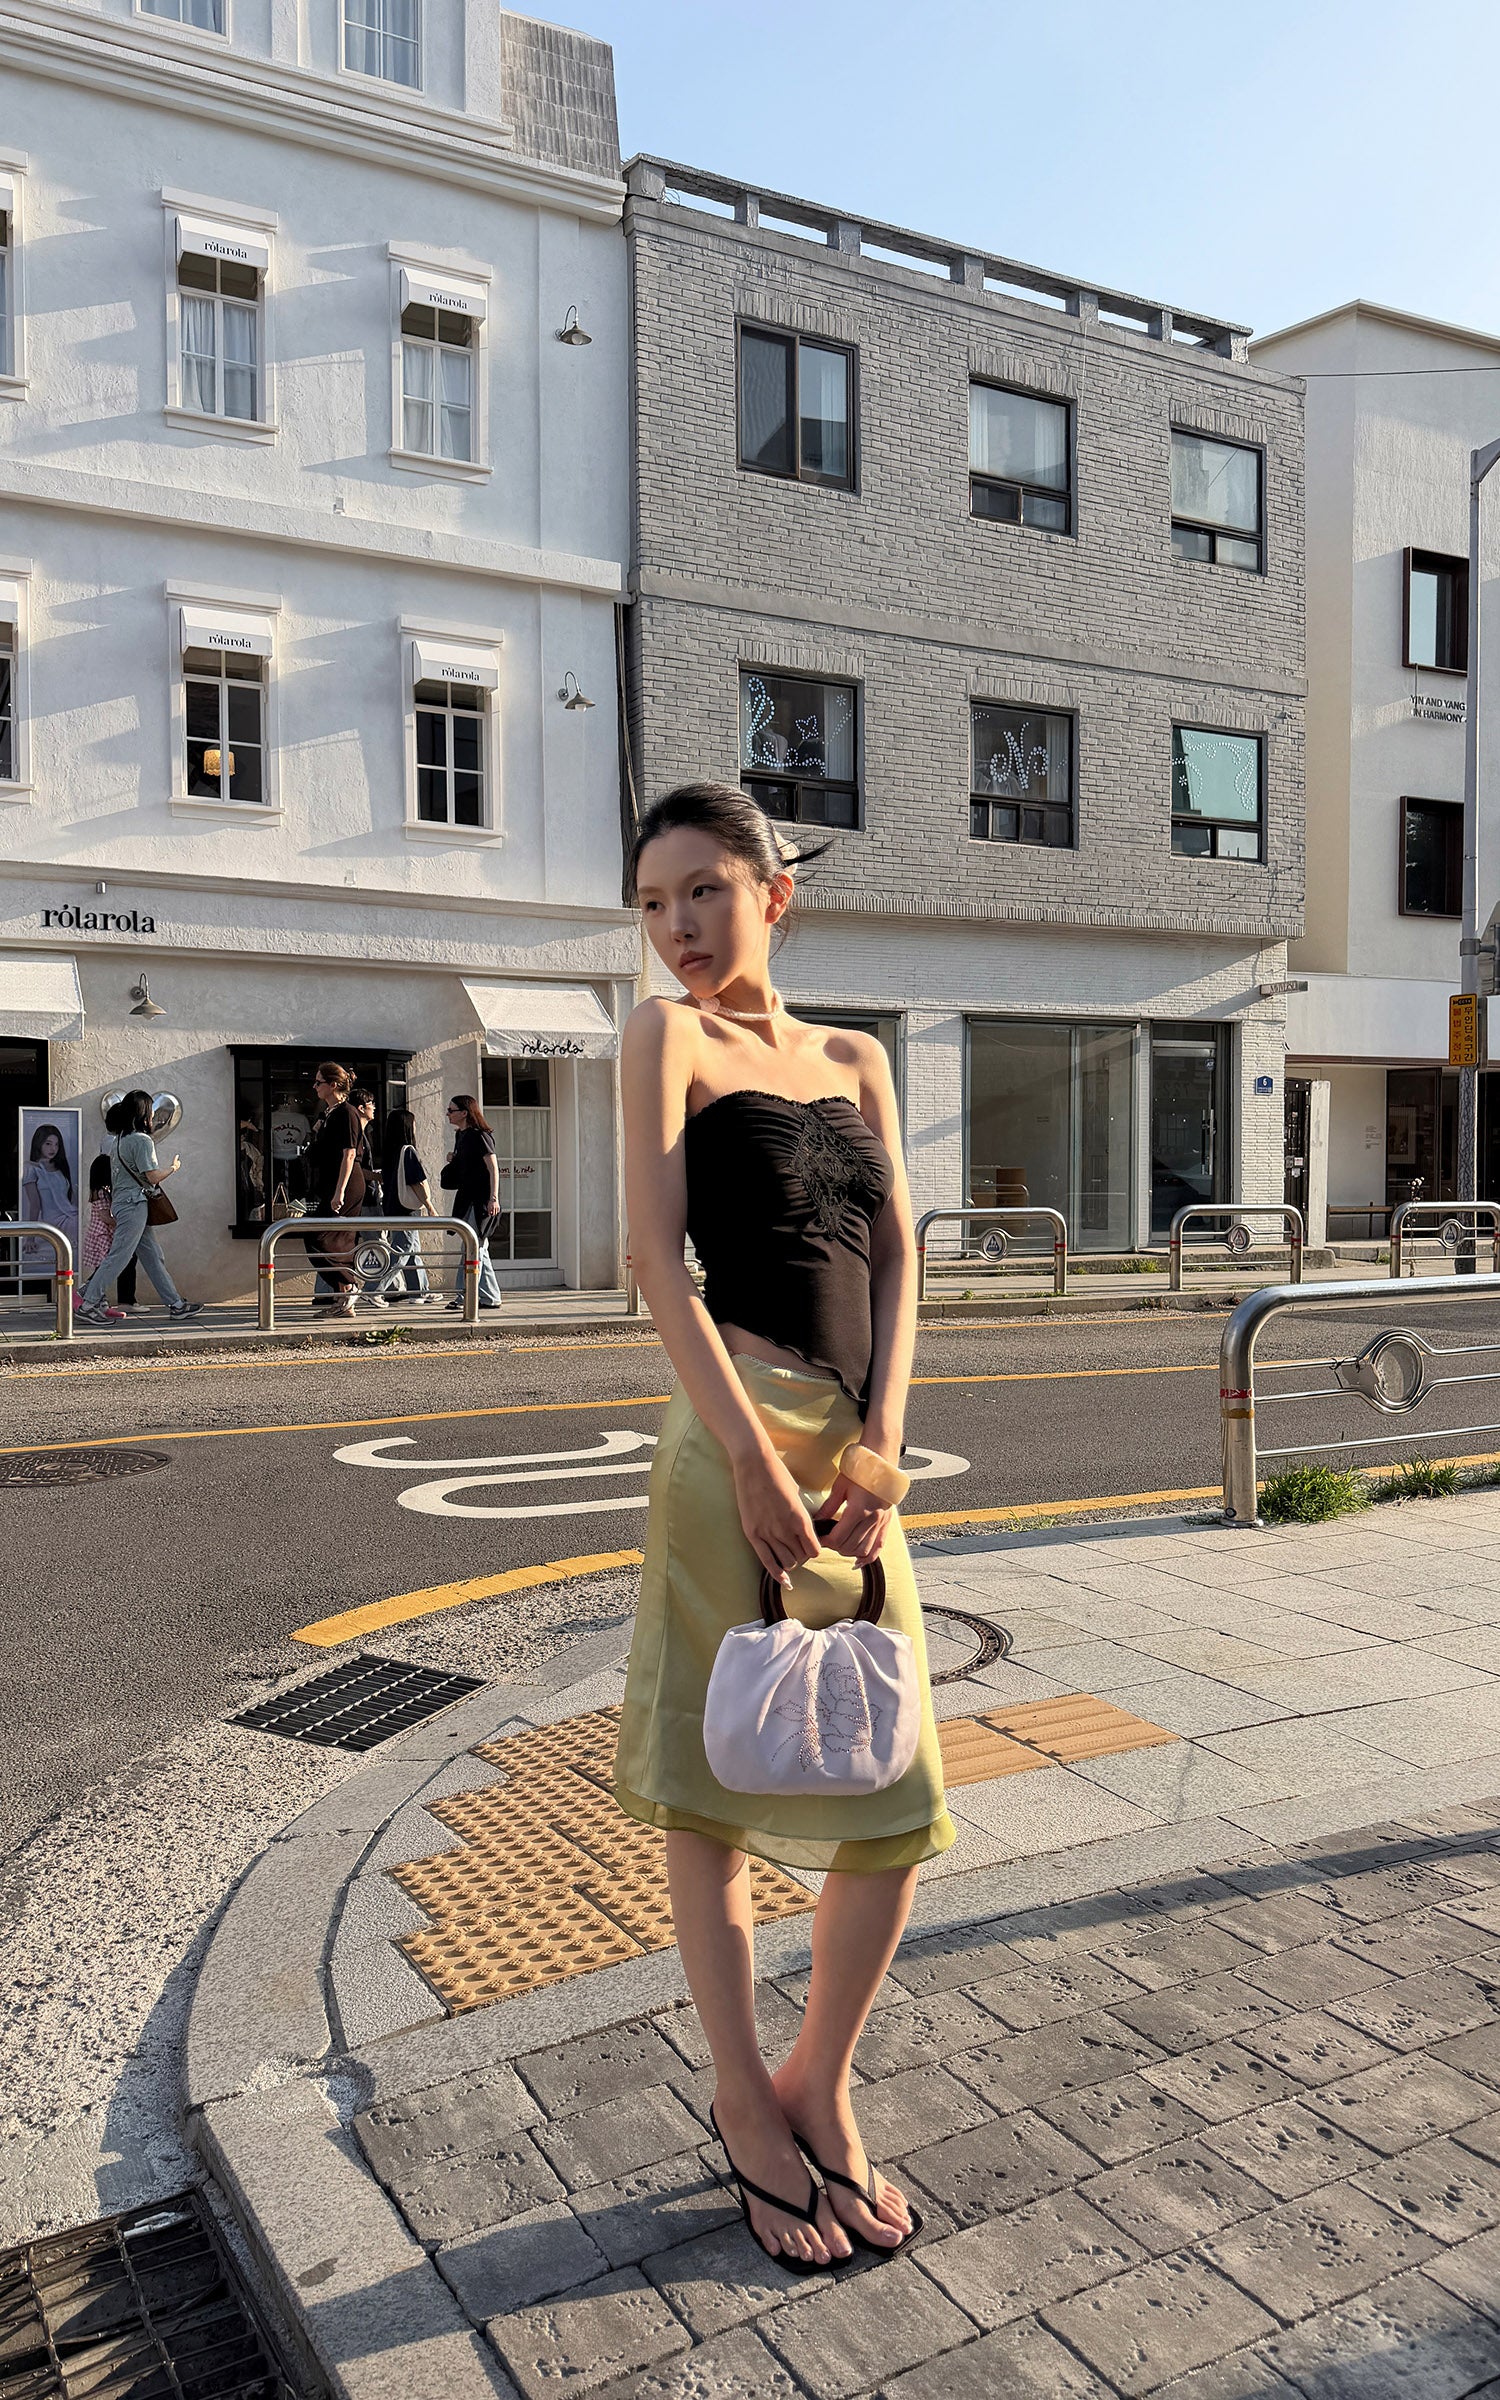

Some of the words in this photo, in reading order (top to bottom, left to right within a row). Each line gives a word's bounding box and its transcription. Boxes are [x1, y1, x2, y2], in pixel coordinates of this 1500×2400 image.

[1410, 694, 1424, 705] YIN
[1425, 697, 1442, 708] AND
[1444, 699, 1466, 711] YANG
[1413, 707, 1422, 717] IN
[1464, 1006, 1473, 1062] 무인단속구간
[1262, 1078, 1268, 1086] 6
